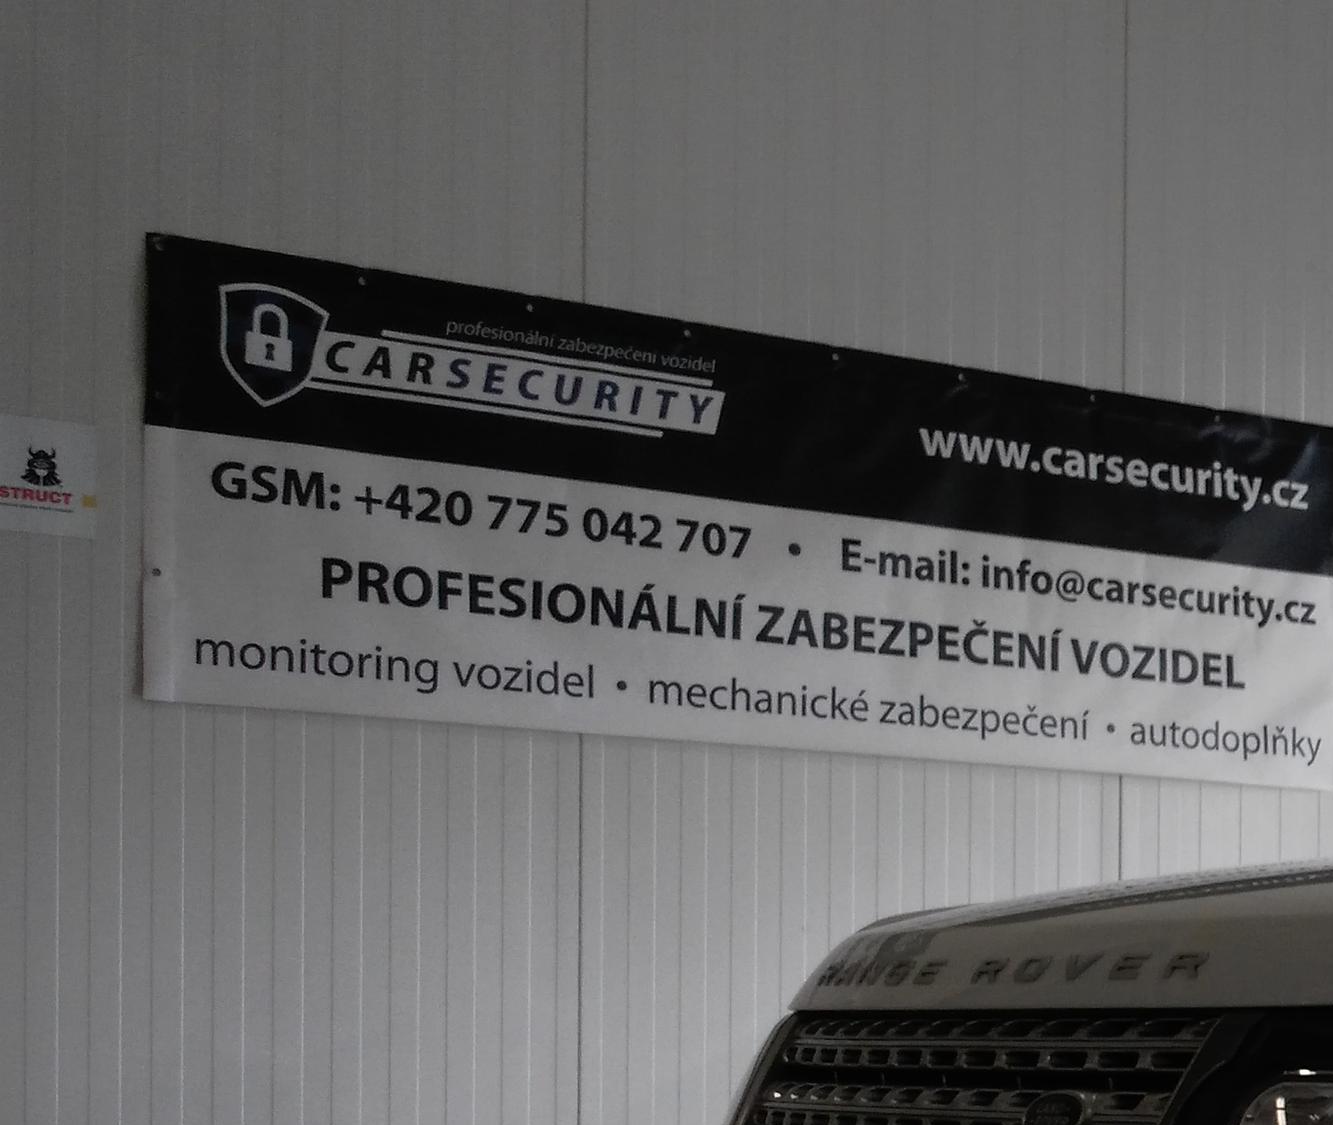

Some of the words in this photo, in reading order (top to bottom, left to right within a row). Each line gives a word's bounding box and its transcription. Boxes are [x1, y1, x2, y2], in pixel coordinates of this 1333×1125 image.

[325, 340, 714, 425] CARSECURITY
[660, 354, 717, 373] vozidel
[918, 427, 1309, 511] www.carsecurity.cz
[211, 461, 341, 511] GSM:
[354, 484, 473, 526] +420
[487, 495, 569, 537] 775
[582, 507, 662, 549] 042
[676, 518, 752, 559] 707
[840, 537, 971, 586] E-mail:
[981, 554, 1317, 628] info@carsecurity.cz
[321, 556, 746, 641] PROFESIONÁLNÍ
[755, 604, 1063, 672] ZABEZPEČENÍ
[1070, 638, 1246, 689] VOZIDEL
[194, 638, 440, 694] monitoring
[453, 660, 595, 698] vozidel
[648, 677, 869, 723] mechanické
[878, 694, 1091, 741] zabezpečení
[1129, 719, 1323, 766] autodoplňky
[816, 958, 948, 988] RANGE
[970, 950, 1211, 985] ROVER
